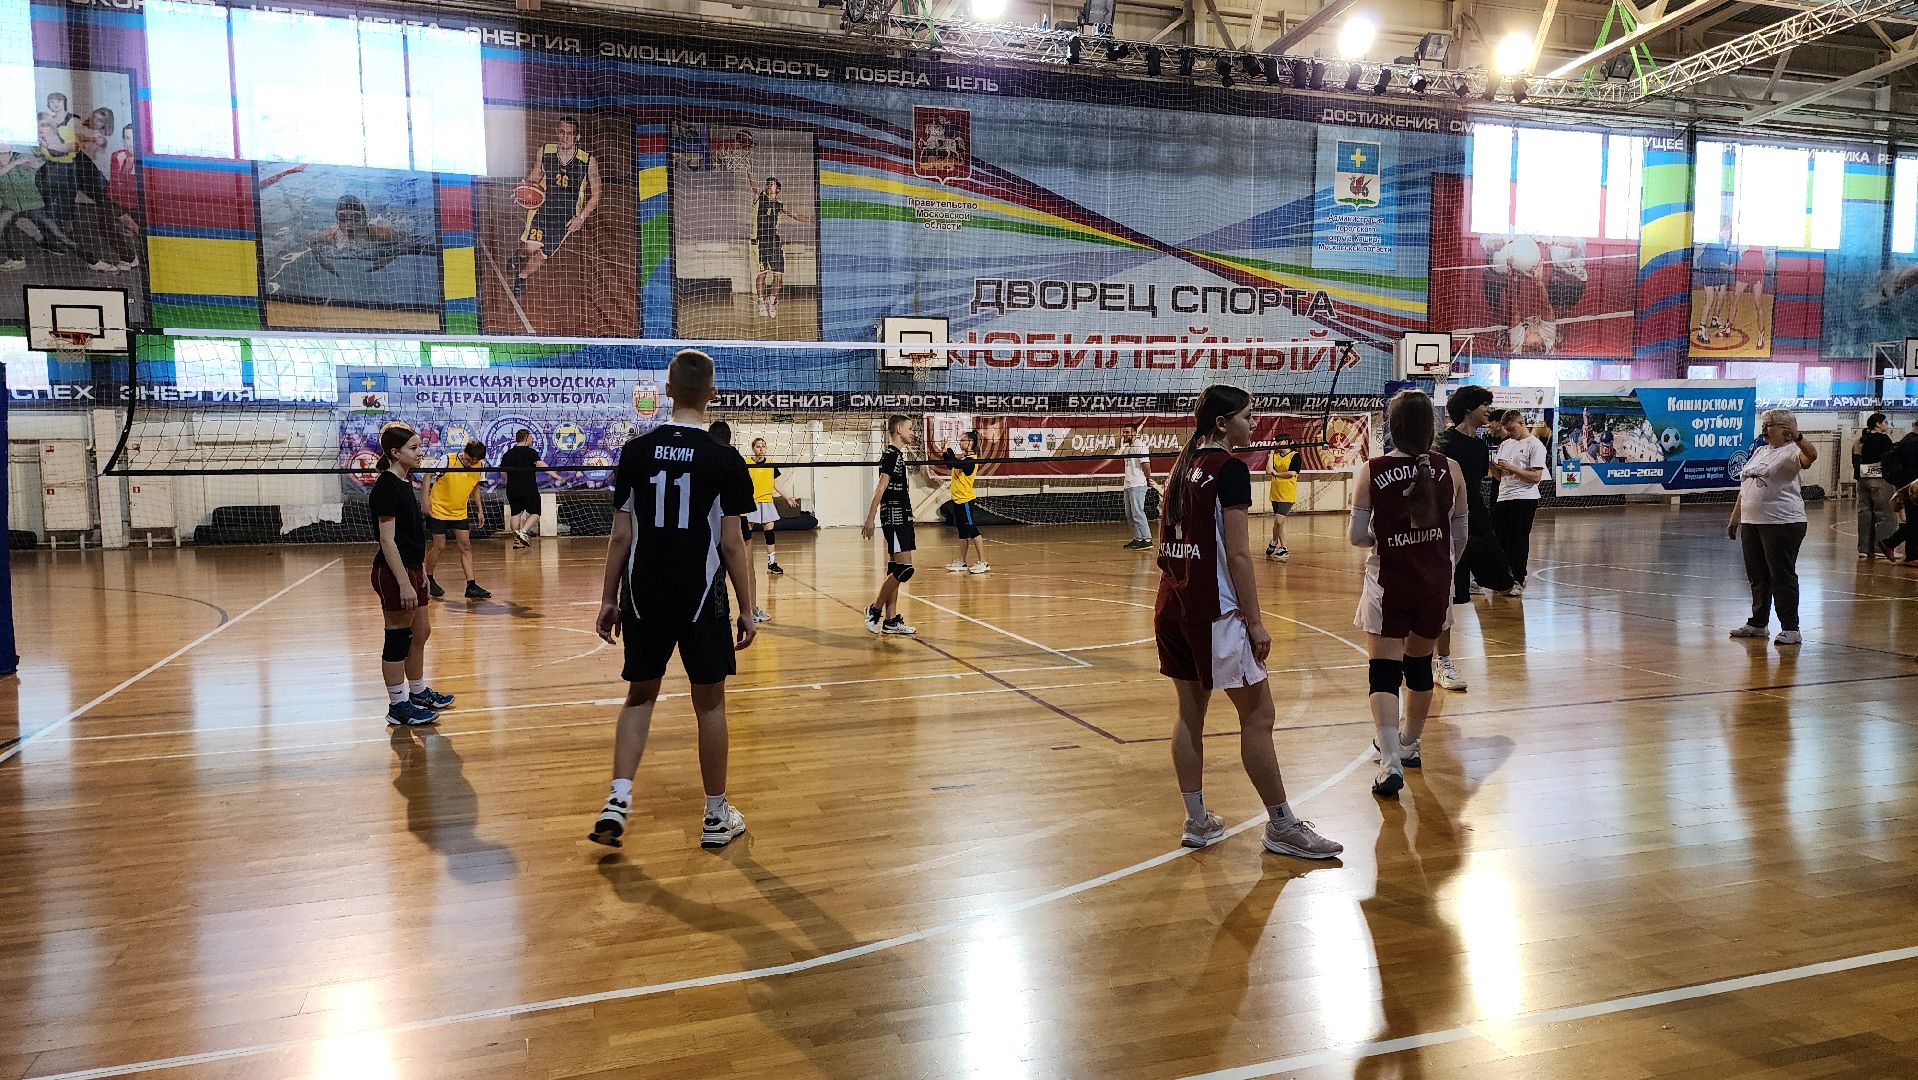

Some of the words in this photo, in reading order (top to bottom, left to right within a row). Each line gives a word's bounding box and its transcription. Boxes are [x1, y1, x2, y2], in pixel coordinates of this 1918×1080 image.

[465, 26, 580, 53] ЭНЕРГИЯ
[600, 41, 707, 66] ЭМОЦИИ
[725, 54, 830, 78] РАДОСТЬ
[845, 66, 931, 88] ПОБЕДА
[946, 75, 999, 92] ЦЕЛЬ
[1322, 108, 1439, 131] ДОСТИЖЕНИЯ
[908, 198, 978, 210] Правительство
[916, 210, 970, 220] Московской
[1328, 214, 1384, 225] Администрация
[924, 221, 962, 231] области
[530, 229, 543, 241] 26
[971, 278, 1157, 317] ДВОРЕЦ
[1171, 286, 1337, 318] СПОРТА
[948, 326, 1361, 371] «ЮБИЛЕЙНЫЙ»
[402, 374, 513, 388] КАШИРСКАЯ
[517, 375, 616, 391] ГОРОДСКАЯ
[11, 385, 95, 400] СПЕХ
[120, 385, 254, 401] ЭНЕРГИЯ
[416, 391, 524, 407] ФЕДЕРАЦИЯ
[527, 391, 605, 404] ФУТБОЛА
[708, 394, 834, 408] СТИЖЕНИЯ
[850, 394, 960, 408] СМЕЛОСТЬ
[974, 396, 1049, 410] РЕКОРД
[1068, 396, 1158, 409] БУДУЩЕЕ
[1302, 396, 1384, 409] ДИНАМИК
[1667, 396, 1744, 412] Каширскому
[1777, 398, 1816, 408] ПОЛЕТ
[1825, 397, 1895, 407] ГАРМОНИЯ
[1071, 434, 1115, 451] ОДНА
[1694, 434, 1715, 447] 100
[1719, 433, 1743, 447] лет!
[654, 445, 694, 462] ВЕКИН
[1200, 474, 1214, 488] 7
[1374, 465, 1418, 490] ШКОЛА
[1439, 468, 1447, 482] 7
[649, 470, 691, 529] 11
[1387, 527, 1443, 547] г.КАШИРА
